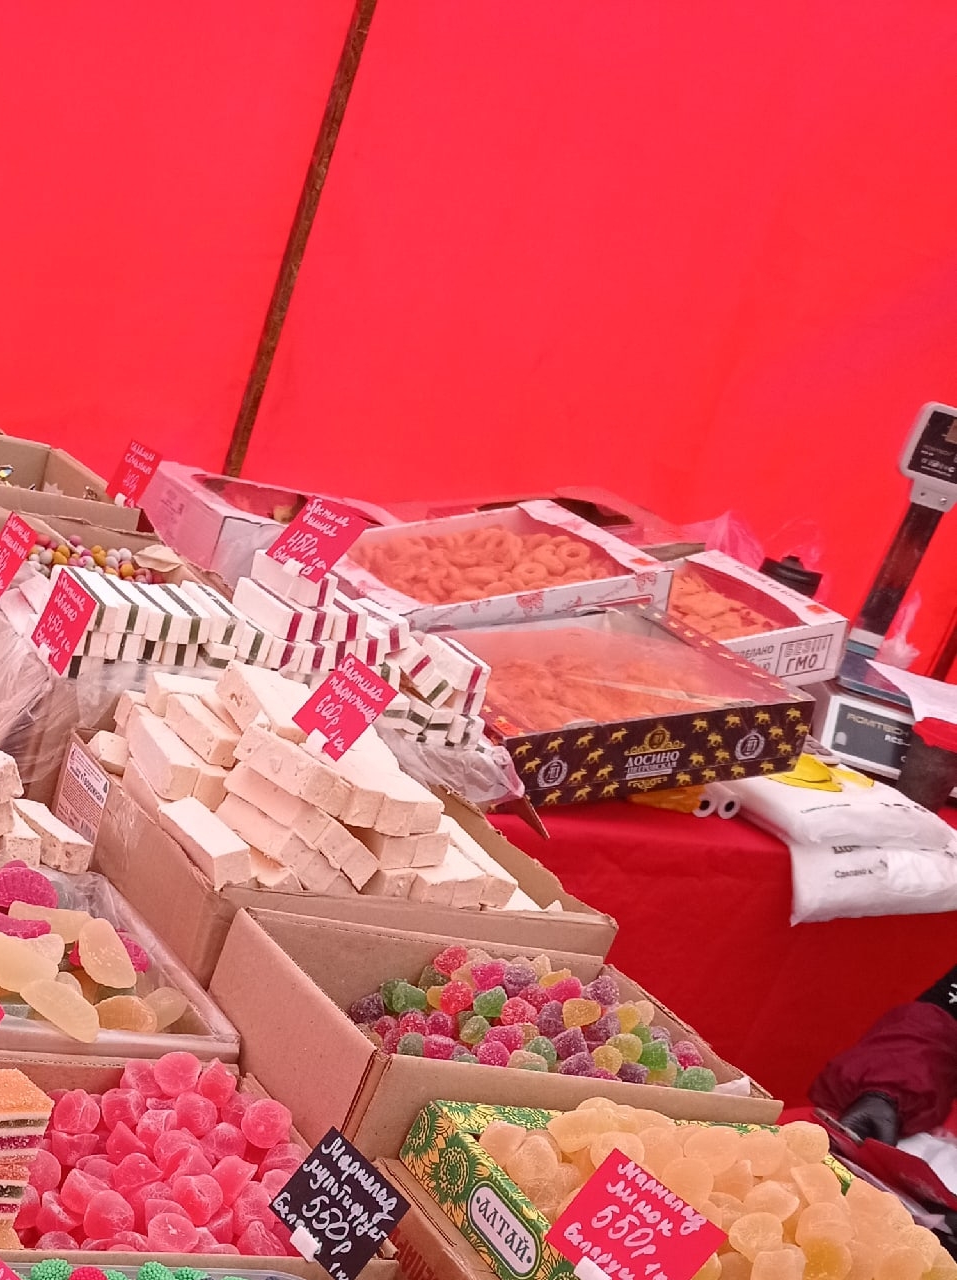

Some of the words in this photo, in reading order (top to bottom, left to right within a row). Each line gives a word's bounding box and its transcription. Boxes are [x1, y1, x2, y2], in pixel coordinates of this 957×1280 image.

[786, 655, 818, 674] ГМО
[626, 751, 679, 767] ЛОСИНО
[322, 1137, 397, 1225] Мармелад
[605, 1180, 673, 1237] лимон
[616, 1158, 708, 1236] Мармелад
[301, 1195, 352, 1255] 550р
[478, 1196, 530, 1263] АЛТАЙ
[591, 1204, 656, 1259] 550р
